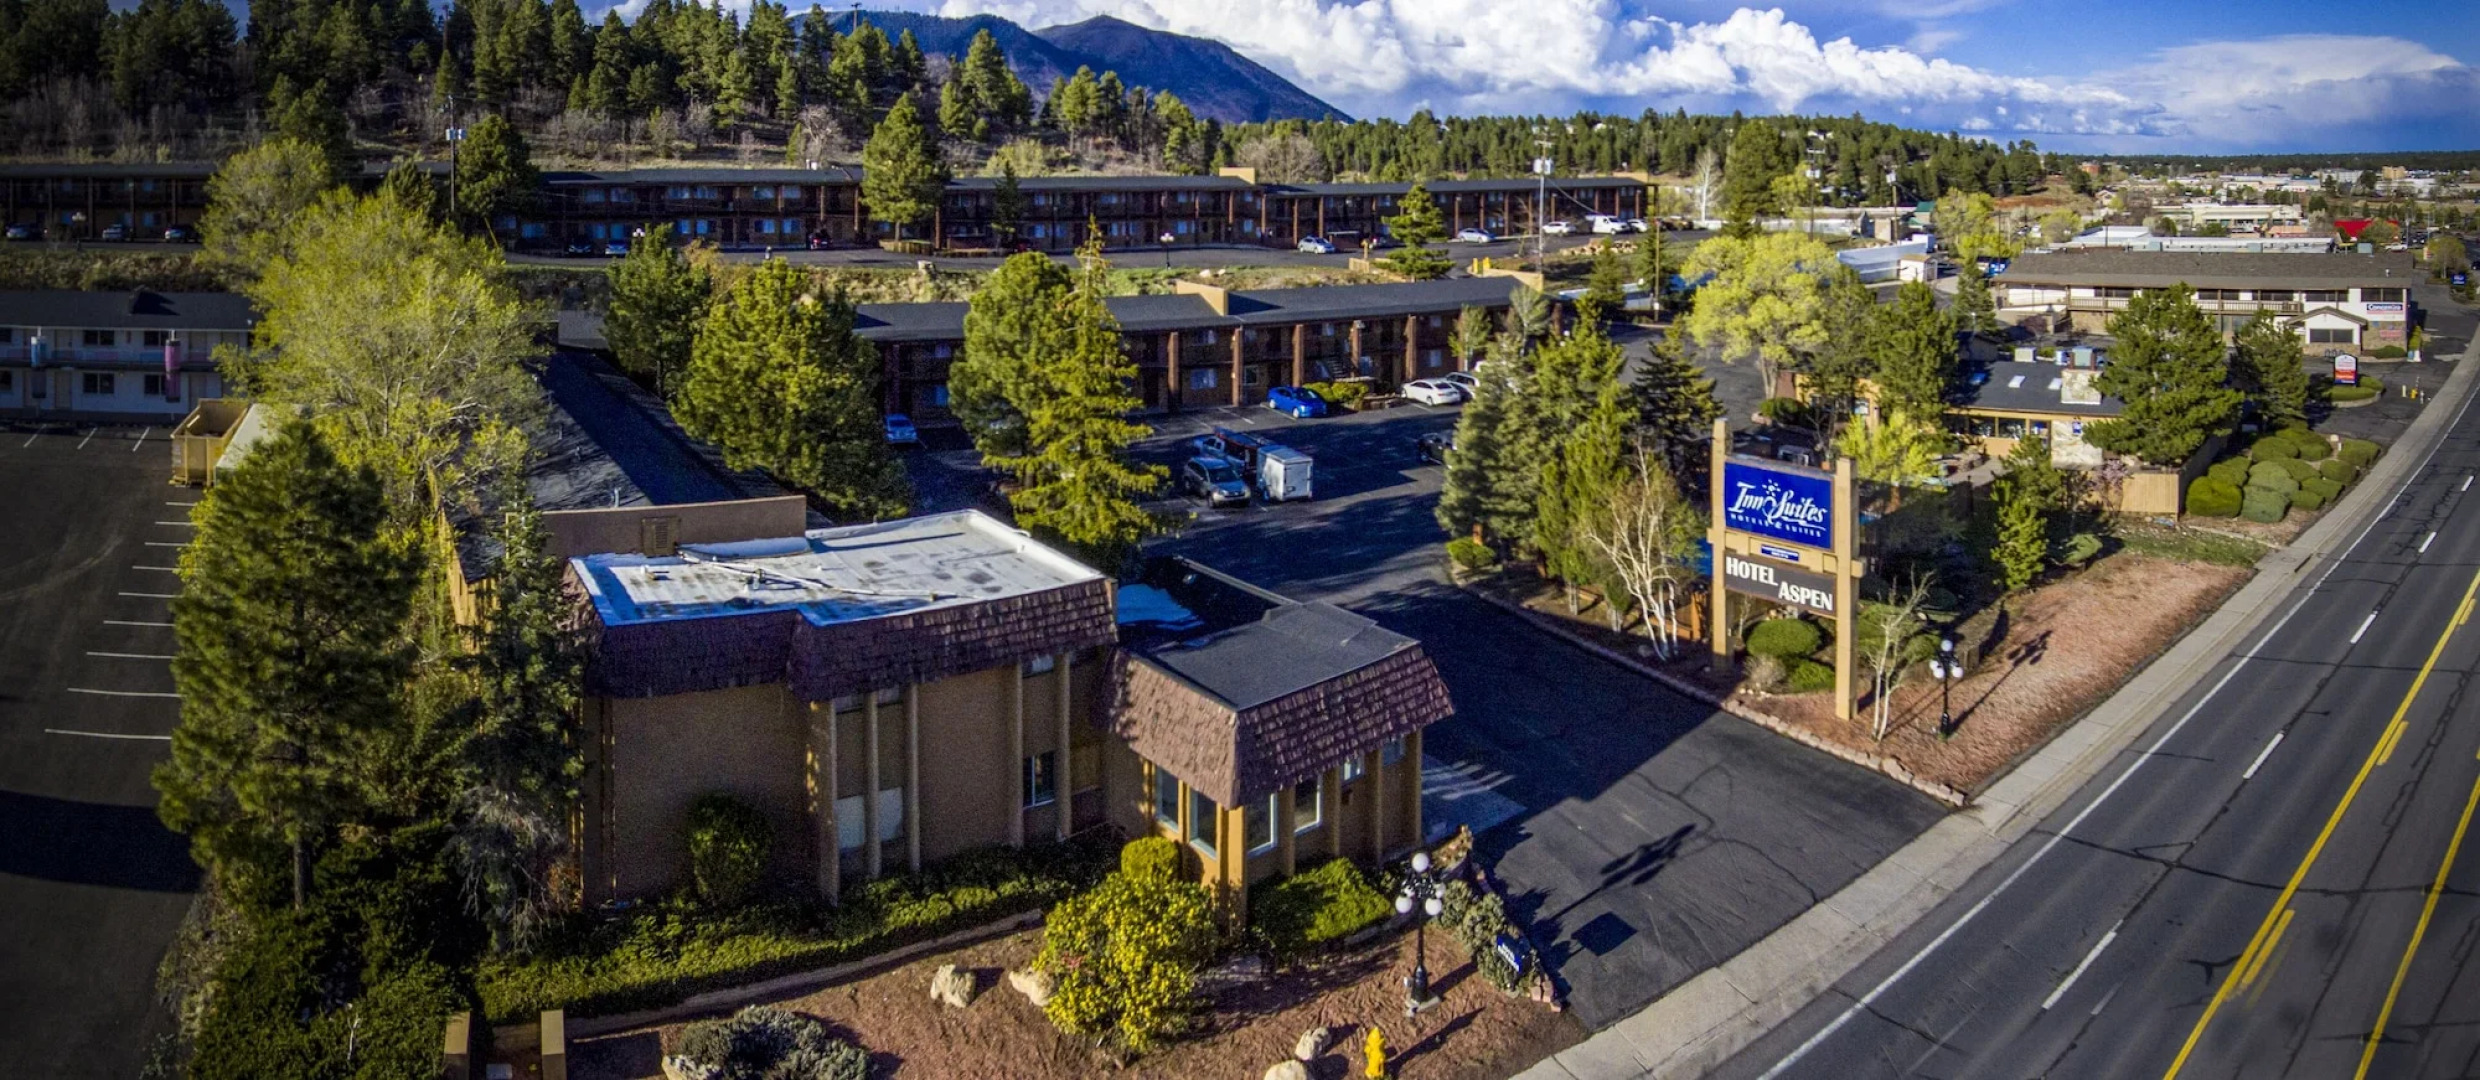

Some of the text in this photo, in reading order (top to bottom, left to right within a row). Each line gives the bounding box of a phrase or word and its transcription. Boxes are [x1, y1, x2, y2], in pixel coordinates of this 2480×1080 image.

[1731, 513, 1769, 528] HOTELS
[1785, 525, 1821, 538] SUITES
[1726, 556, 1833, 611] HOTEL ASPEN
